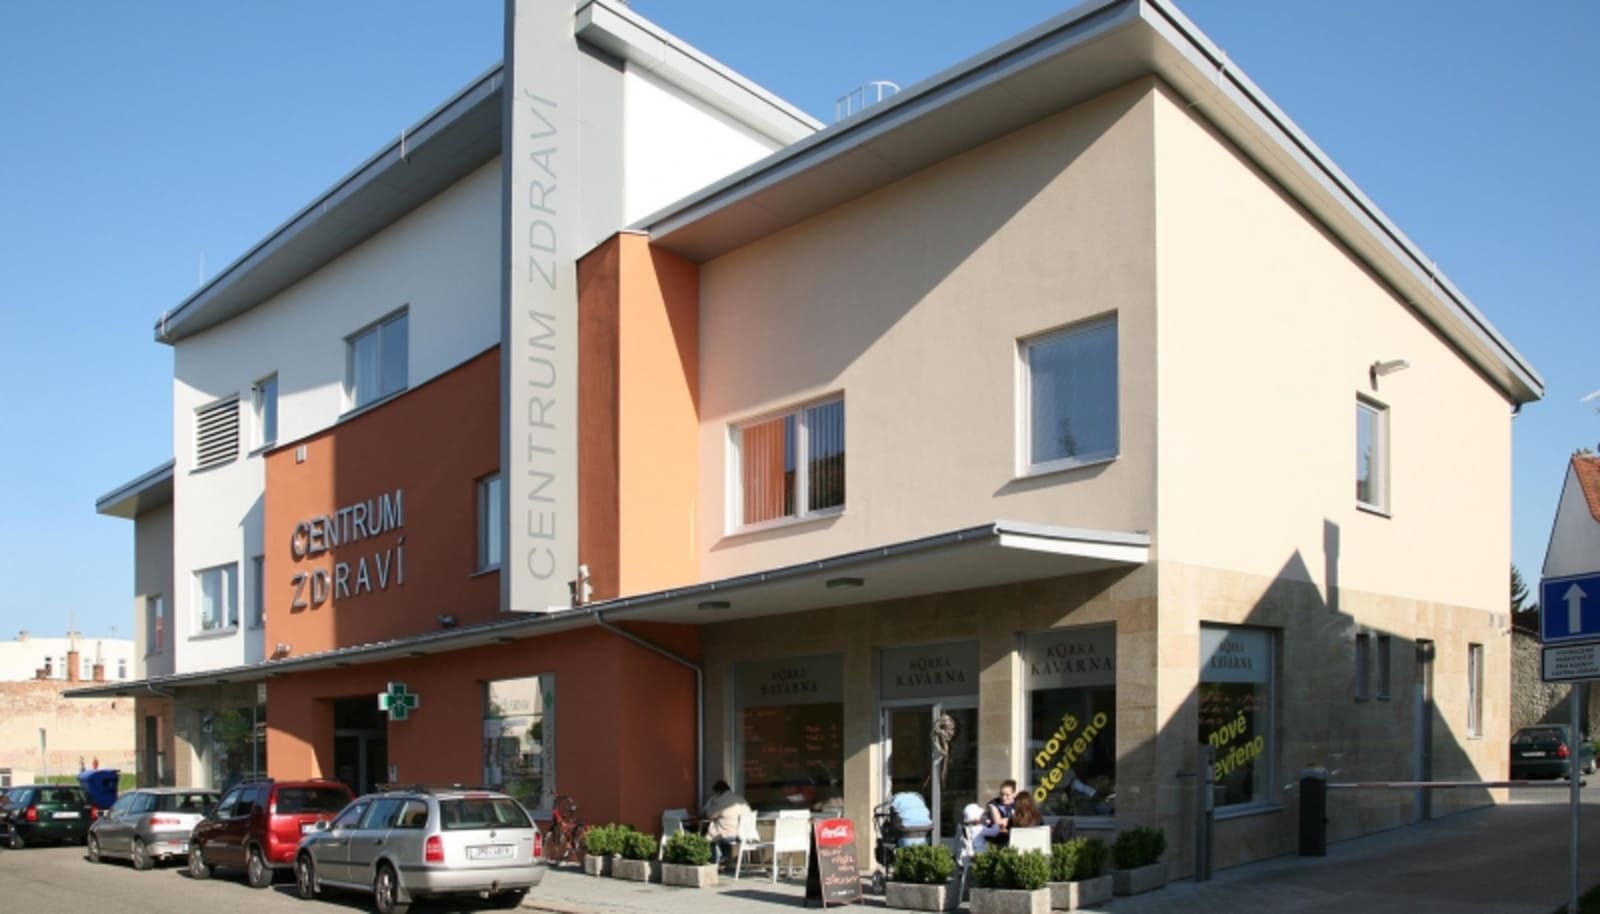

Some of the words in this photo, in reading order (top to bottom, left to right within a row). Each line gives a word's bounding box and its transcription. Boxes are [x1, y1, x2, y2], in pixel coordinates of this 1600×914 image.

[525, 88, 559, 291] ZDRAVÍ
[527, 311, 557, 581] CENTRUM
[293, 488, 404, 557] CENTRUM
[291, 538, 405, 609] ZDRAVÍ
[1033, 711, 1108, 803] otevřeno
[1034, 712, 1079, 769] nově
[1208, 710, 1247, 749] nově
